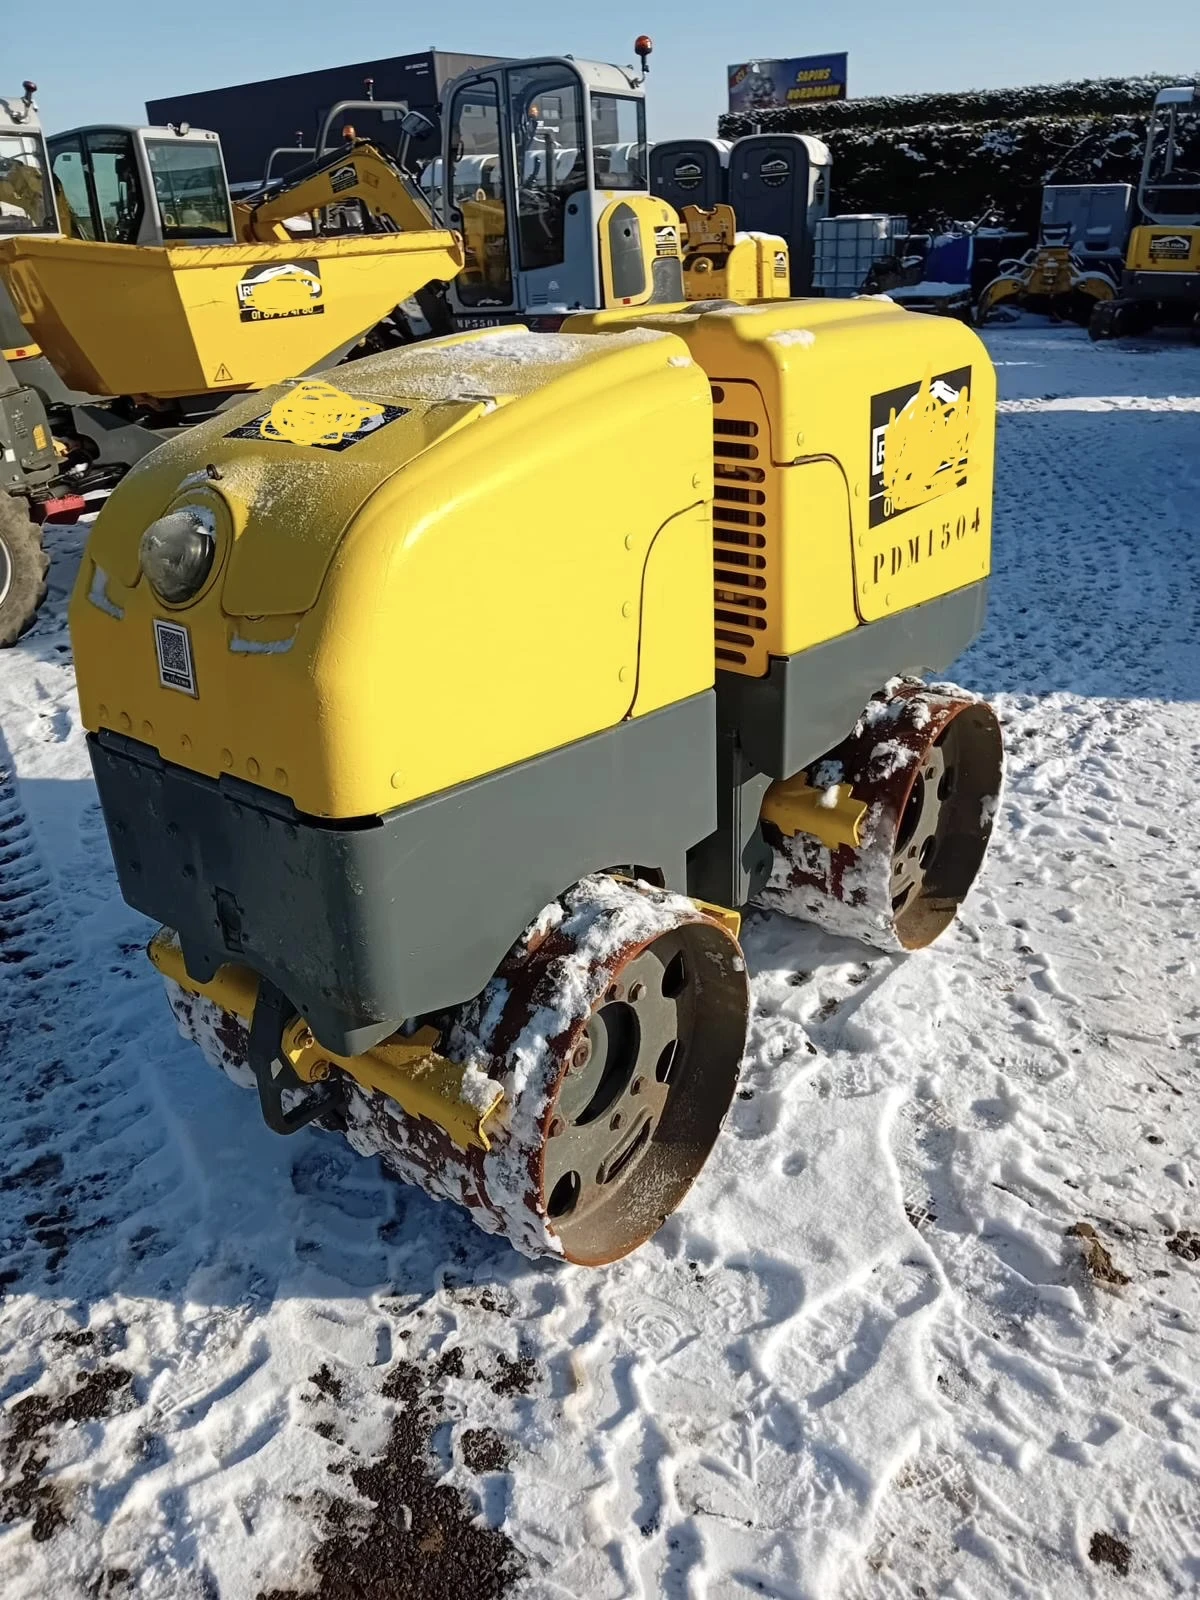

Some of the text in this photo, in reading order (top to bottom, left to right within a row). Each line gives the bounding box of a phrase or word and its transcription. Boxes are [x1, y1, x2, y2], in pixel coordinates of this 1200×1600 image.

[795, 68, 831, 82] SAPINS
[787, 84, 841, 99] NORDMANN
[873, 506, 981, 584] PDM1504
